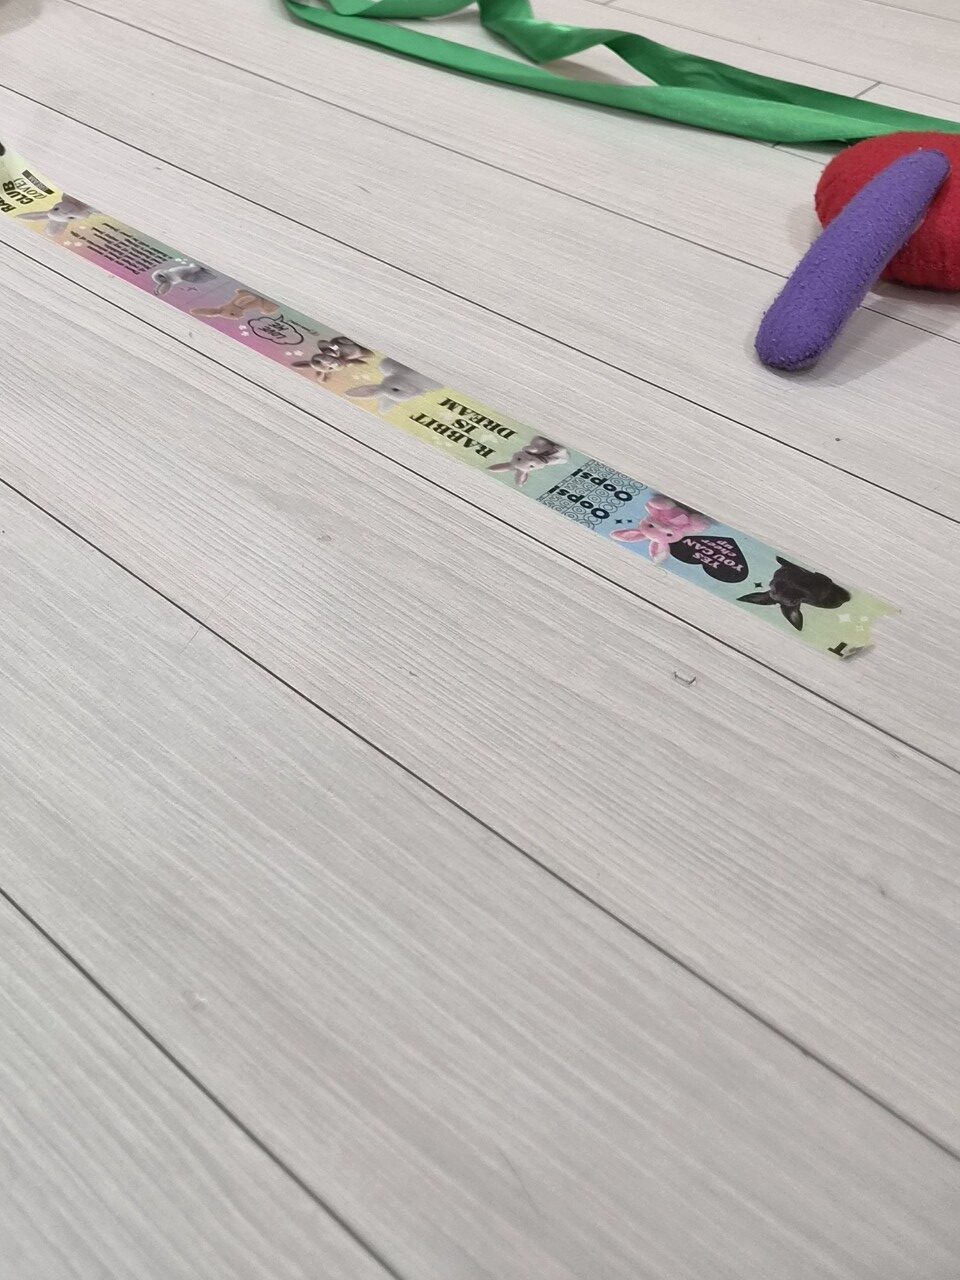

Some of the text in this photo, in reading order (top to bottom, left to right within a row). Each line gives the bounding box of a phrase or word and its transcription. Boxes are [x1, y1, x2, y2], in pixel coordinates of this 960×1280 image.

[2, 180, 34, 205] CLUB
[13, 177, 47, 200] (LOVE)
[437, 398, 518, 440] DREAM
[452, 418, 480, 435] IS
[409, 412, 497, 459] RABBIT
[571, 468, 633, 502] Oops!
[548, 485, 610, 519] Oops!
[682, 537, 744, 572] YOU CAN
[701, 538, 737, 557] cheer
[717, 540, 734, 551] up
[692, 552, 720, 569] YES
